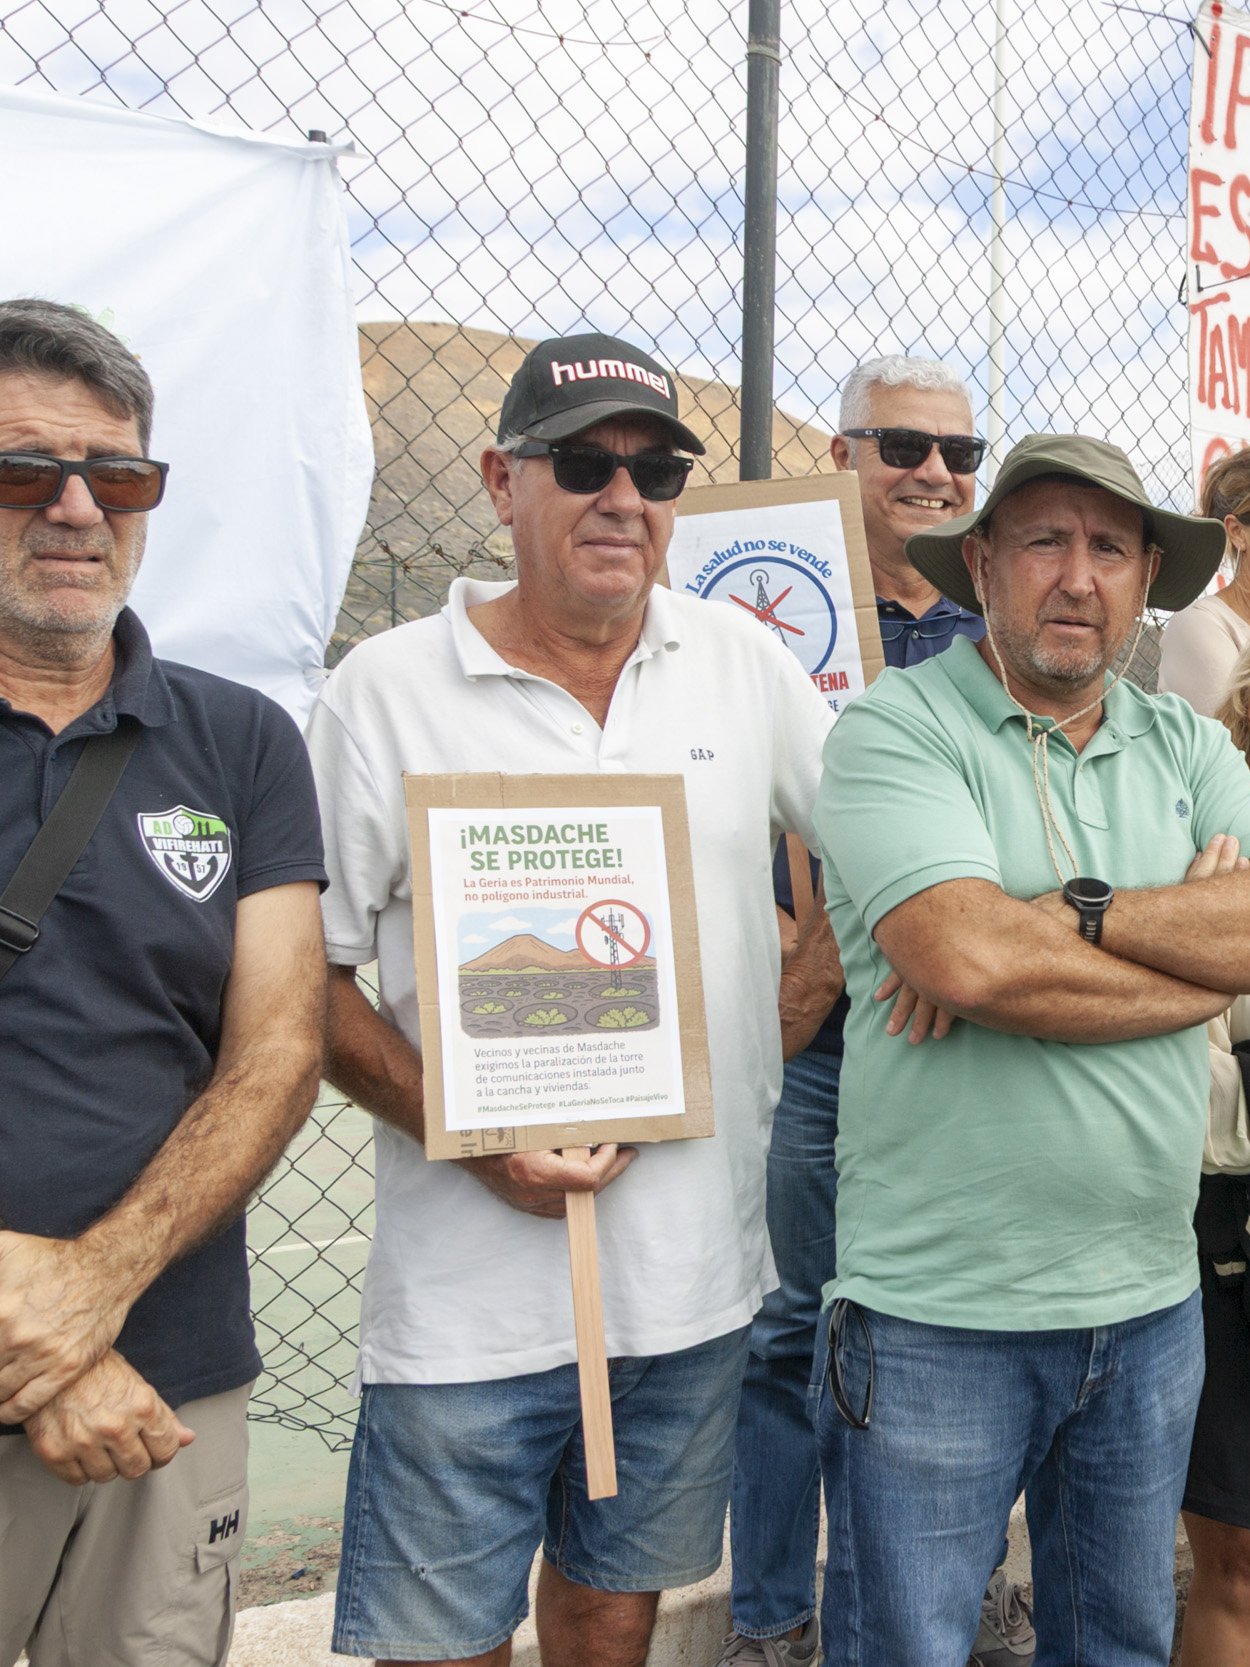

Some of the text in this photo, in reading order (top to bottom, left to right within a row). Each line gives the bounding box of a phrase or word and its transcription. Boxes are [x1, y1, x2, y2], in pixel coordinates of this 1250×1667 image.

[551, 358, 671, 400] hummel
[685, 539, 833, 595] La salud no se vende
[809, 671, 850, 693] TENA
[460, 823, 610, 849] ¡MASDACHE
[470, 848, 624, 871] SE PROTEGE!
[463, 873, 635, 888] La Geria es Patrimonio Mundial,
[464, 892, 479, 901] no
[532, 888, 588, 900] industrial.
[474, 1040, 626, 1059] Vecinos y vecinas de Masdache
[475, 1053, 644, 1073] exigimos la paralización de la torre
[475, 1065, 646, 1084] de comunicaciones instalada junto
[476, 1089, 483, 1097] a
[485, 1086, 495, 1097] la
[496, 1084, 533, 1096] cancha
[534, 1085, 541, 1096] y
[477, 1092, 669, 1113] #MasdacheSeProtege #LaGeriaNoSeToca #PaisajeVivo
[208, 1508, 240, 1545] HH
